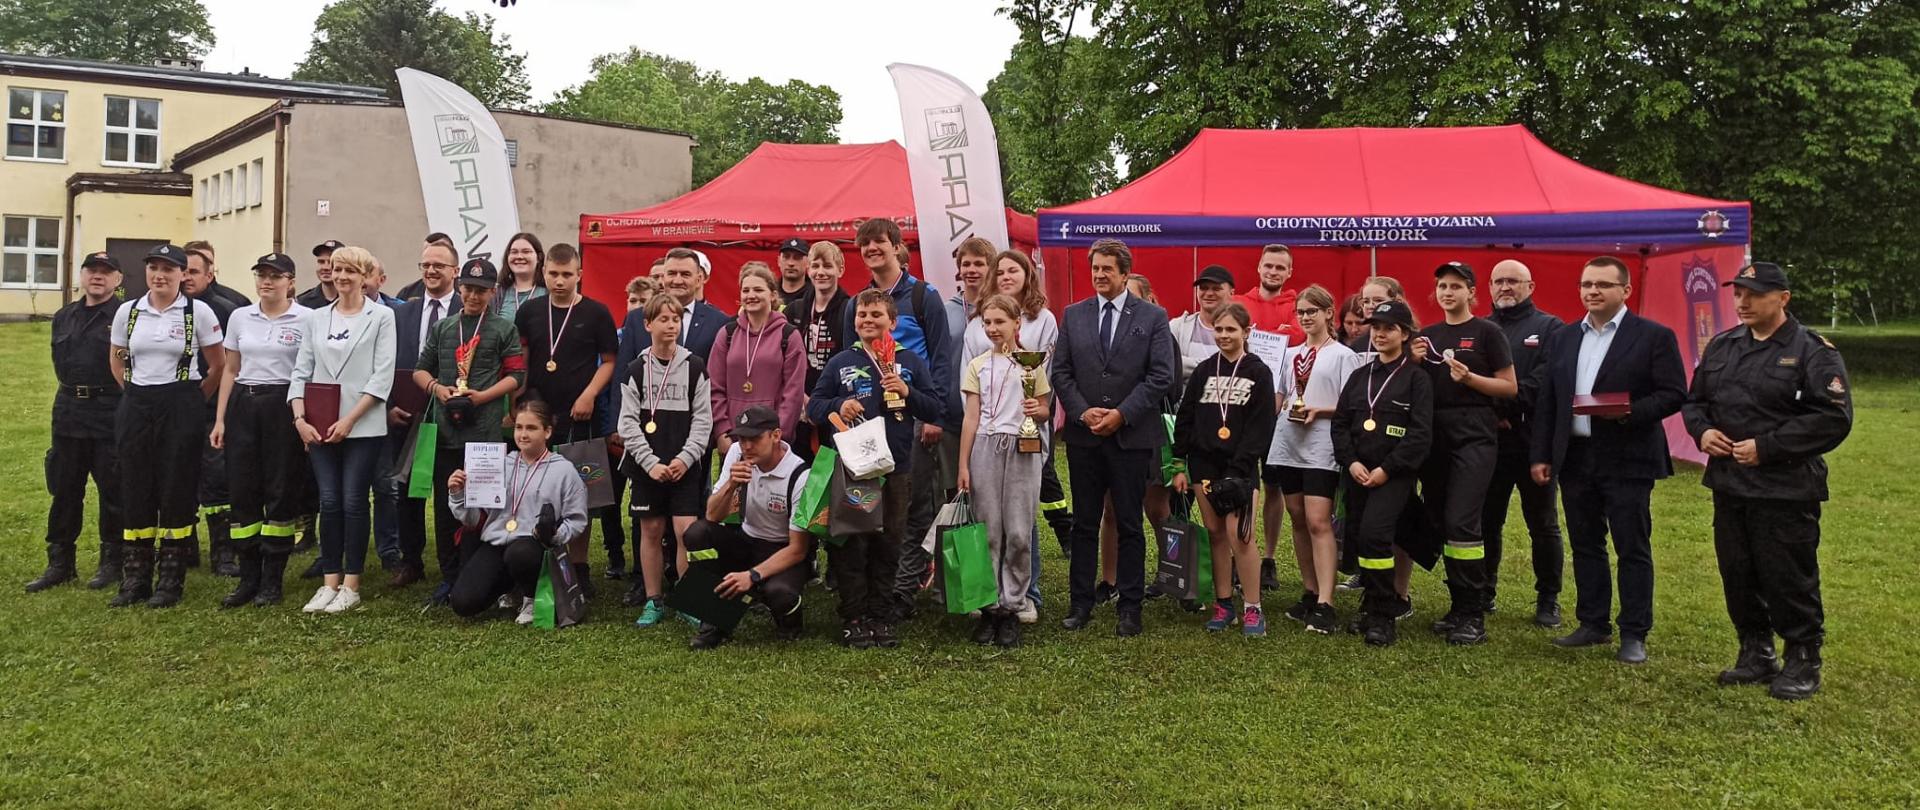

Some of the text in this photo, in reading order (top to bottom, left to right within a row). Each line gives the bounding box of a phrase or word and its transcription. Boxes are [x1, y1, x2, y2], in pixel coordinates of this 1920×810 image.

[1075, 223, 1162, 234] /OSPFROMBORK
[1255, 216, 1357, 229] OCHOTNICZA
[652, 225, 716, 236] W BRANIEWIE
[1319, 229, 1429, 242] FROMBORK
